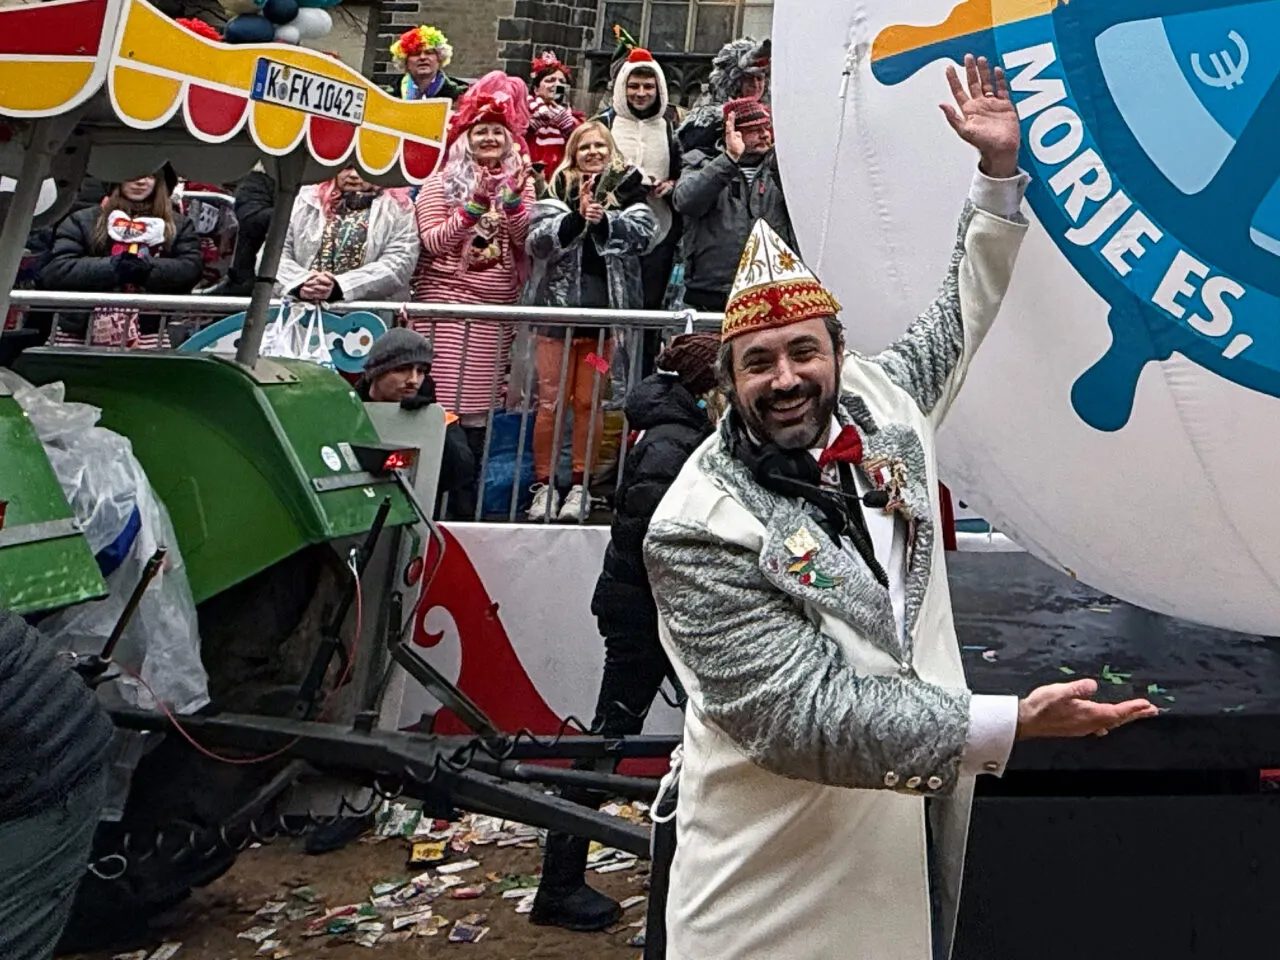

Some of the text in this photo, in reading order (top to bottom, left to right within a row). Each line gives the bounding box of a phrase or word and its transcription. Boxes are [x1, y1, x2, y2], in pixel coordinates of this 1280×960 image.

[266, 66, 281, 98] K
[289, 73, 314, 107] FK
[313, 81, 354, 118] 1042
[1002, 42, 1163, 278] MORJE
[1151, 250, 1255, 361] ES,
